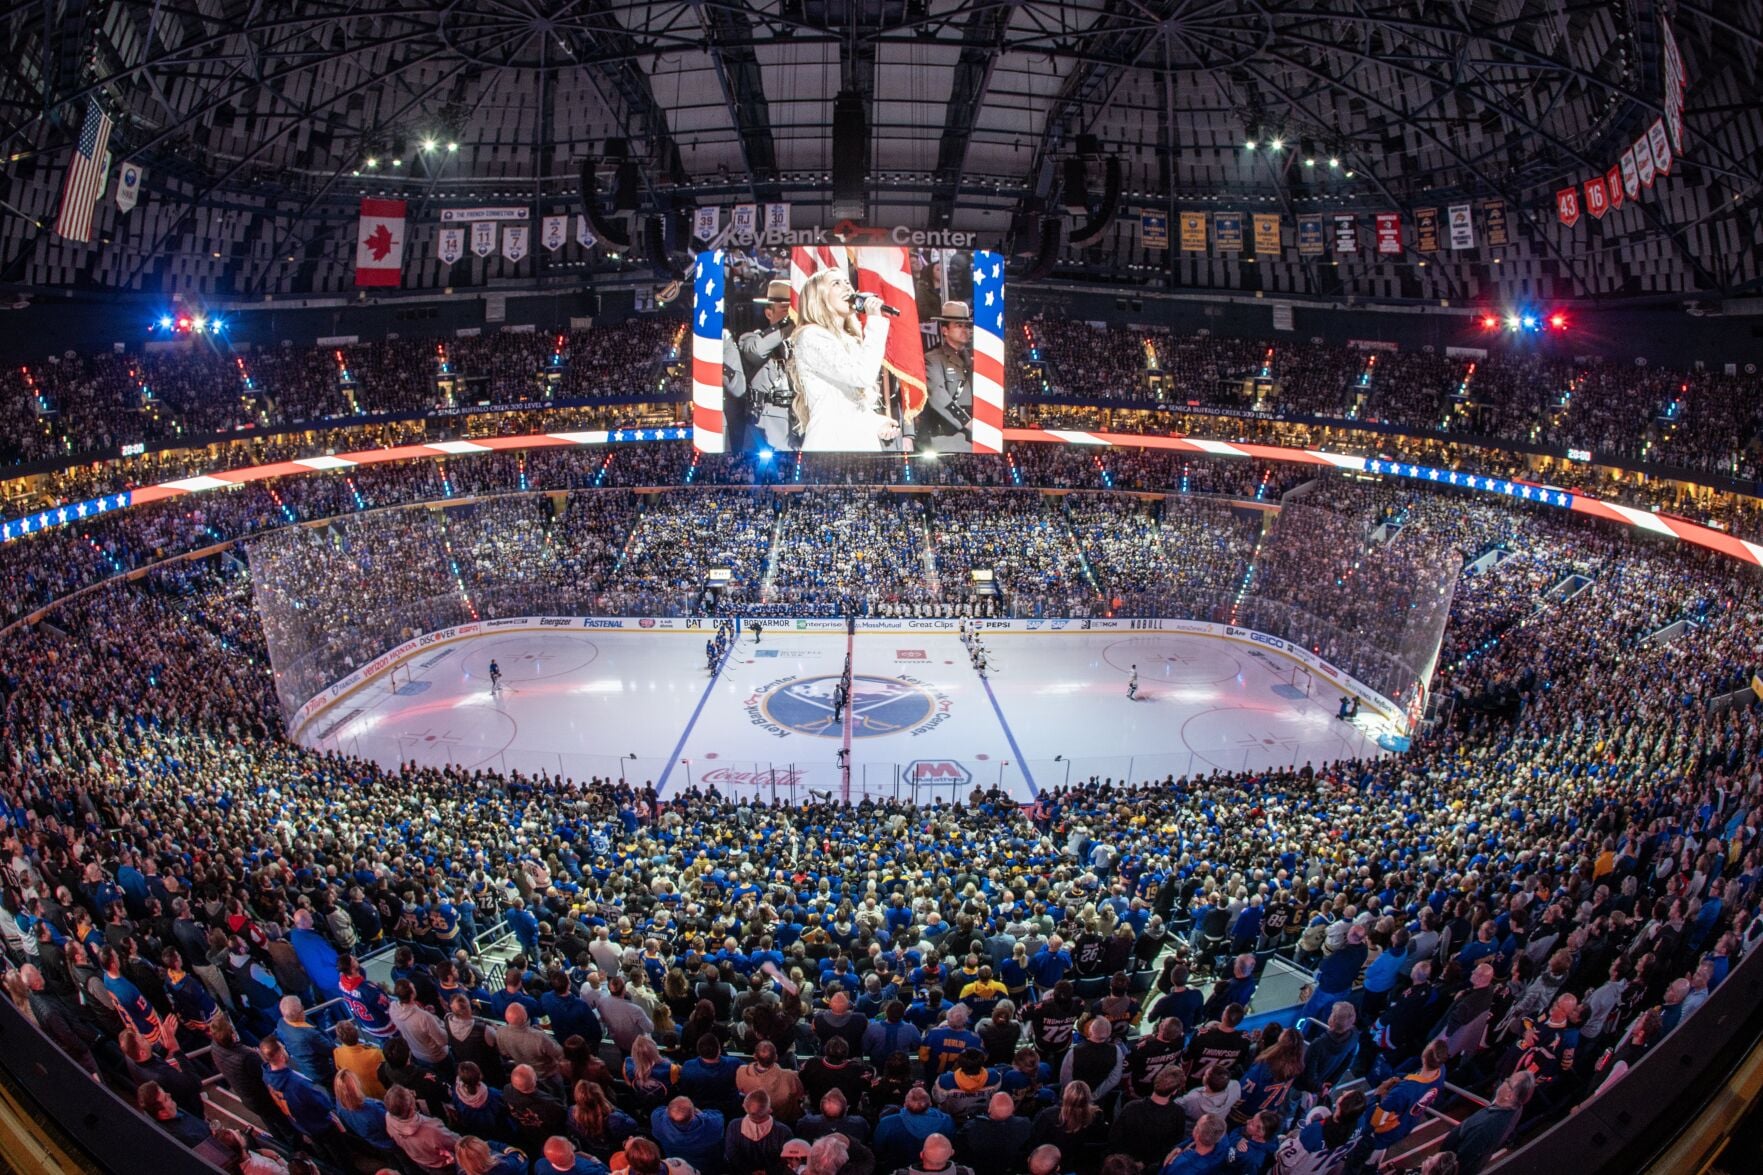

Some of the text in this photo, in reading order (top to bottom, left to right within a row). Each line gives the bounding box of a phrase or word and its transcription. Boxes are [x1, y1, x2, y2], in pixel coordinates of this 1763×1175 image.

[1610, 174, 1620, 199] 11
[1588, 184, 1603, 208] 16
[1560, 194, 1576, 216] 43
[700, 216, 713, 226] 39
[737, 215, 750, 224] RJ
[771, 213, 784, 224] 30
[478, 232, 489, 242] 11
[551, 226, 559, 236] 2
[722, 225, 976, 249] KeyBank Center
[445, 239, 457, 250] 14
[512, 237, 519, 247] 7
[437, 408, 460, 416] SENECA
[461, 406, 489, 414] BUFFALO
[1168, 404, 1191, 413] SENECA
[1192, 407, 1220, 415] BUFFALO
[1221, 409, 1242, 417] CREEK
[1255, 412, 1274, 420] LEVEL
[122, 443, 145, 456] 20:00
[540, 617, 572, 628] Energizer
[584, 617, 625, 629] FASTENAL
[686, 618, 703, 629] CAT
[863, 621, 902, 629] MassMutual
[908, 620, 954, 630] Great Clips
[1130, 620, 1162, 629] NOBULL
[459, 625, 479, 634] ESPN
[1250, 632, 1284, 648] GEICO
[390, 642, 417, 660] HONDA
[362, 657, 390, 677] verizon
[755, 675, 798, 693] Center
[743, 705, 792, 738] KeyBank
[911, 712, 952, 737] Center
[478, 896, 494, 909] 72
[1267, 914, 1288, 927] 89
[1081, 948, 1098, 962] 26
[1042, 1025, 1072, 1043] 72
[1202, 1047, 1240, 1057] THOMPSON
[1258, 1078, 1294, 1110] 71
